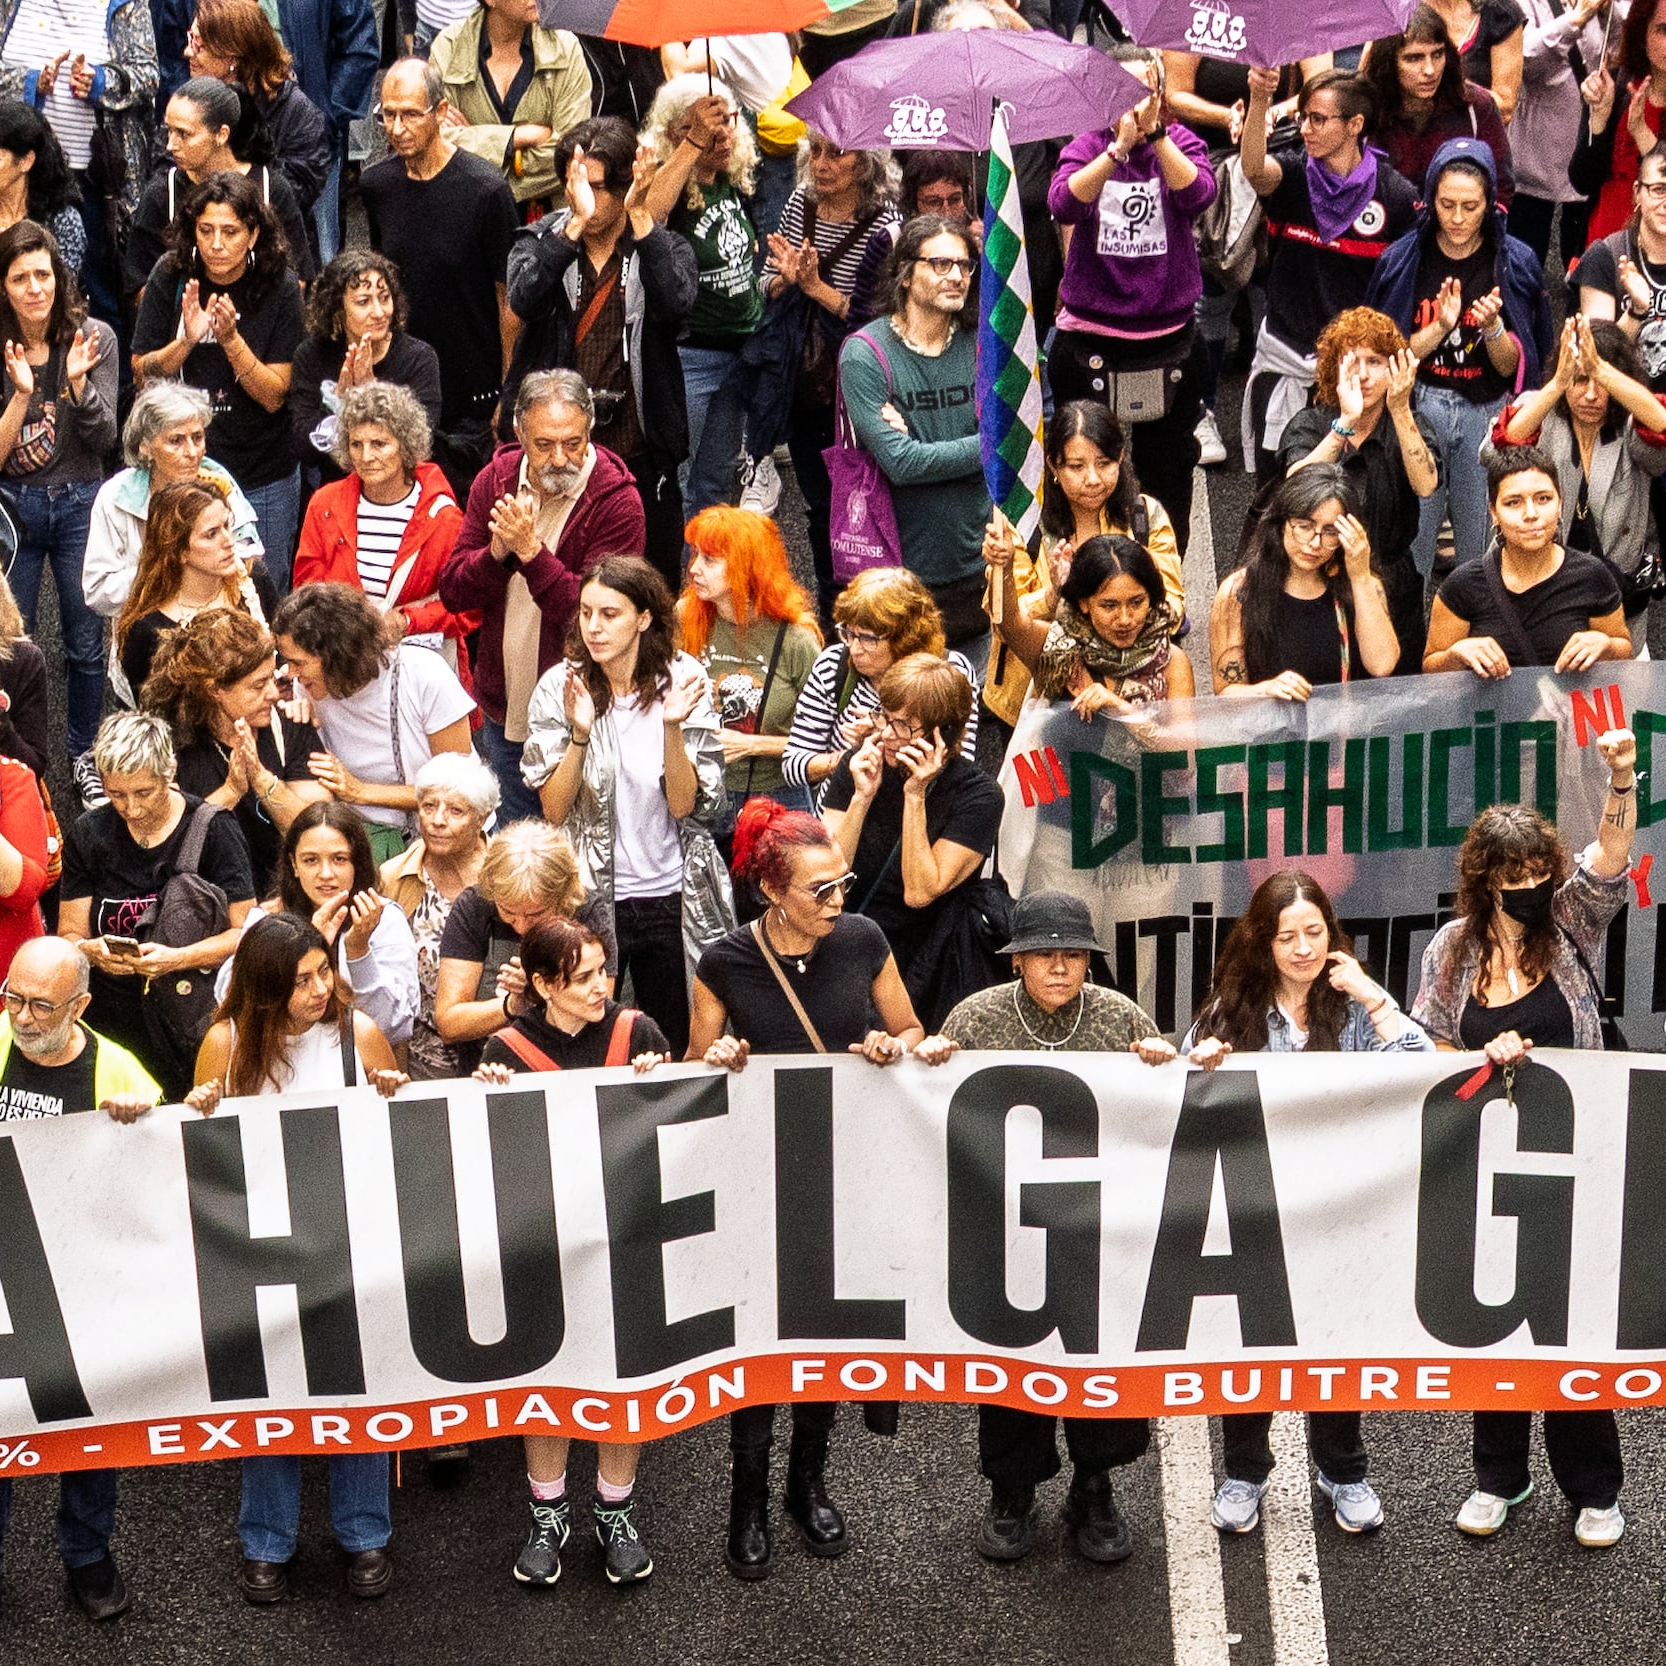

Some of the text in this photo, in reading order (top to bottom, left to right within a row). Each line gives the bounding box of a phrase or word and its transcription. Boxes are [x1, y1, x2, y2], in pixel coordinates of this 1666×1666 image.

[1100, 240, 1166, 254] INSUMISAS
[1104, 227, 1127, 240] LAS
[1012, 745, 1071, 808] NI
[1571, 683, 1626, 749] NI
[1629, 853, 1653, 908] Y
[10, 1088, 63, 1116] VIVIENDA
[181, 1064, 1298, 1402] HUELGA
[148, 1367, 745, 1455] EXPROPIACIÓN
[792, 1359, 1119, 1408] FONDOS
[1164, 1366, 1451, 1405] BUITRE
